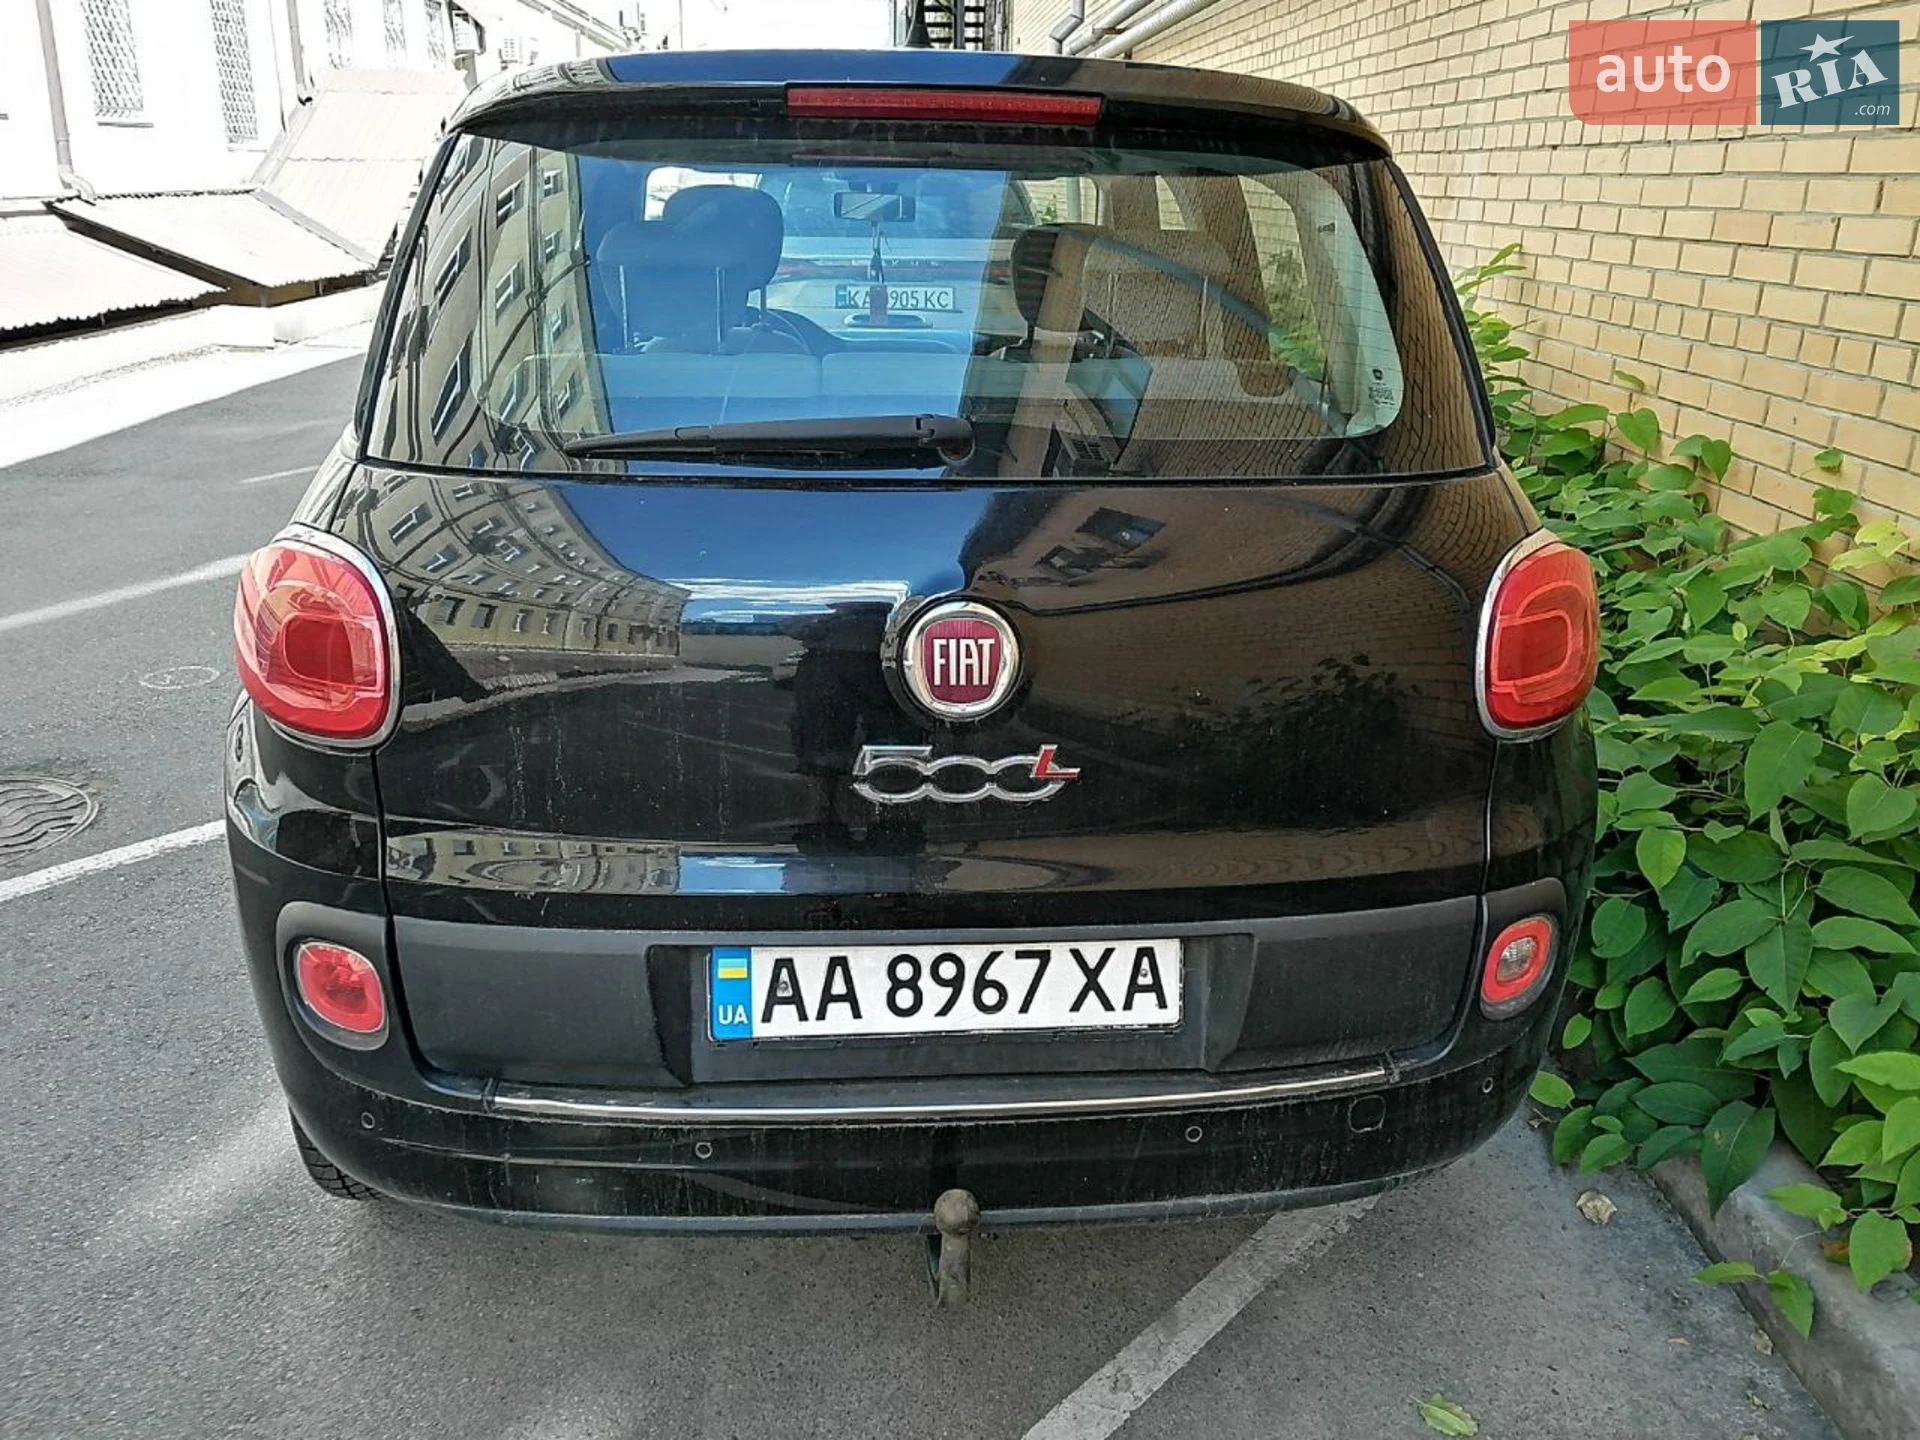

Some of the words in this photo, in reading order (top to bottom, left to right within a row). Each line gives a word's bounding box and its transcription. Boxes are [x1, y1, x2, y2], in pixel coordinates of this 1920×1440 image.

[889, 290, 919, 308] 905
[924, 291, 949, 308] KC
[933, 638, 995, 686] FIAT
[850, 744, 1081, 803] 500L
[761, 956, 863, 1023] AA
[886, 949, 1052, 1018] 8967
[1068, 946, 1168, 1013] XA
[718, 1004, 749, 1025] UA
